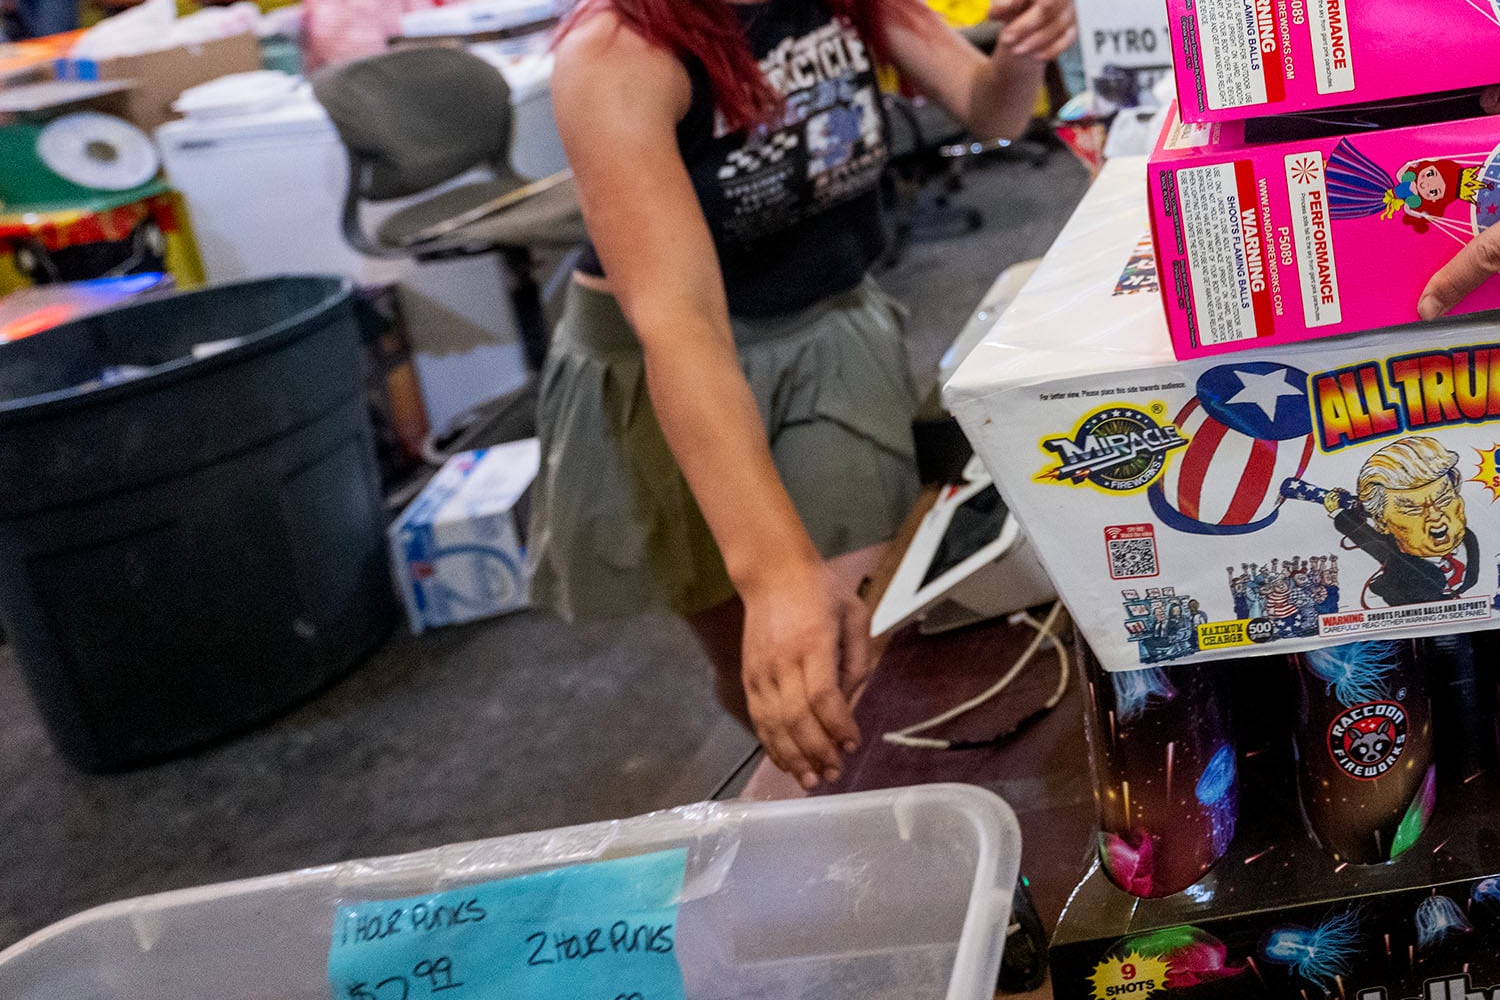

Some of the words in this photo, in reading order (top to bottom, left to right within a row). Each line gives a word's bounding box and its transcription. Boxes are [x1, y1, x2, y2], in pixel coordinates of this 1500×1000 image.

[1094, 30, 1157, 54] PYRO
[1247, 38, 1259, 70] BALLS
[1226, 195, 1240, 234] SHOOTS
[1231, 236, 1245, 277] FLAMING
[1241, 207, 1264, 292] WARNING
[1257, 178, 1282, 316] WWW.PANDAFIREWORKS.COM
[1277, 226, 1292, 265] P5089
[1308, 190, 1333, 304] PERFORMANCE
[1236, 279, 1249, 308] BALLS
[1315, 364, 1399, 449] ALL
[1051, 426, 1180, 463] MIRACLE
[1110, 461, 1162, 489] FIREWORKS
[1201, 623, 1243, 636] MAXIMUM
[1249, 622, 1271, 634] 500
[1322, 614, 1364, 626] WARNING
[1367, 611, 1393, 622] SHOOTS
[1394, 608, 1422, 618] FLAMING
[1424, 605, 1442, 615] BALLS
[1444, 603, 1457, 613] AND
[1458, 601, 1487, 611] REPORTS
[1323, 623, 1360, 634] CAREFULLY
[1362, 620, 1380, 630] READ
[1381, 618, 1404, 628] OTHER
[1405, 615, 1437, 625] WARNING
[1438, 613, 1448, 621] ON
[1450, 611, 1464, 620] SIDE
[1203, 632, 1243, 645] CHARGE
[1332, 705, 1404, 737] RACCOON
[1334, 734, 1406, 776] FIREWORKS
[526, 931, 553, 966] 2
[1121, 963, 1136, 980] 9
[1106, 980, 1155, 996] SHOTS
